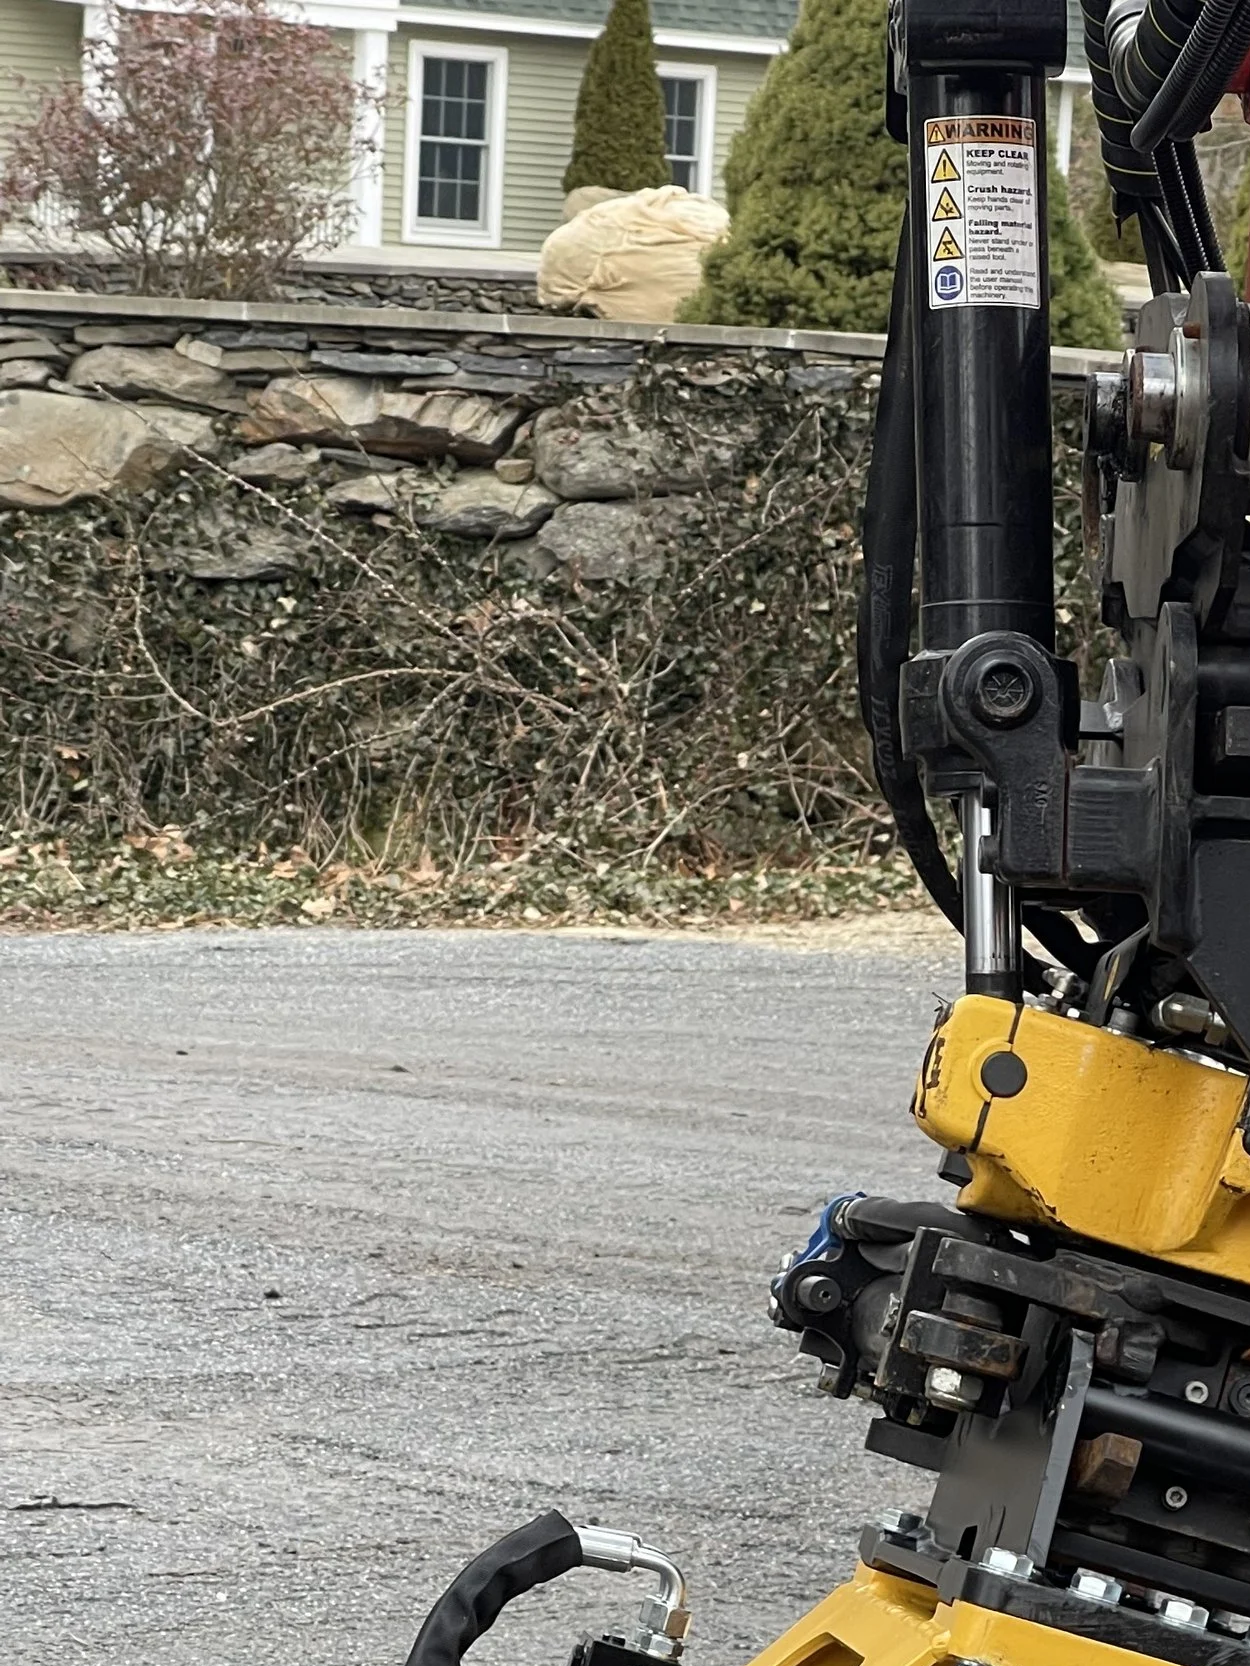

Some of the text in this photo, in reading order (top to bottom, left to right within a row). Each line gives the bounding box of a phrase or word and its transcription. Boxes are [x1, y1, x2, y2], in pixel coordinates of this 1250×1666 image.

[945, 123, 1033, 140] WARNING
[966, 149, 1029, 160] KEEP CLEAR
[967, 185, 1032, 196] Crush hazard.
[968, 219, 1032, 230] Falling material
